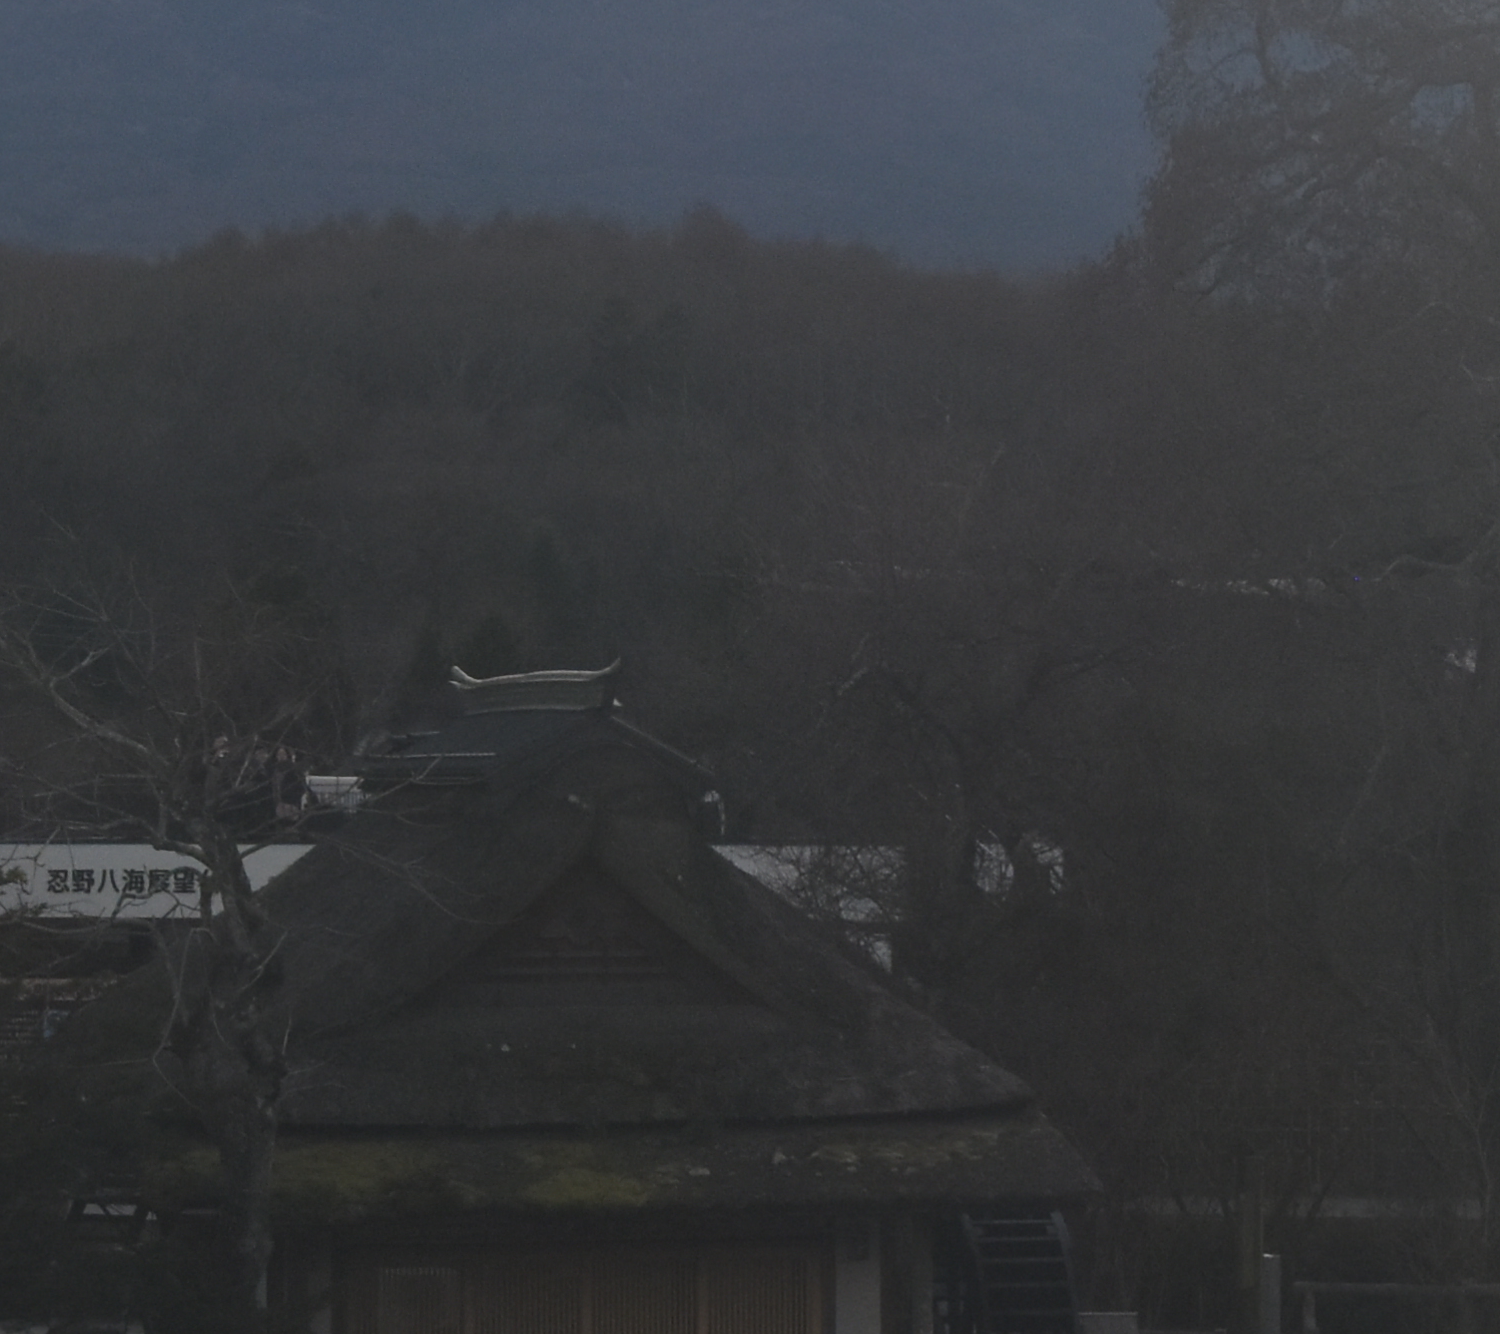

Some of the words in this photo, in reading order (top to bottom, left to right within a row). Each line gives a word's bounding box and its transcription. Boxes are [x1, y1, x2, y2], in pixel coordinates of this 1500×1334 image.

[46, 869, 208, 895] 忍野八海展望
